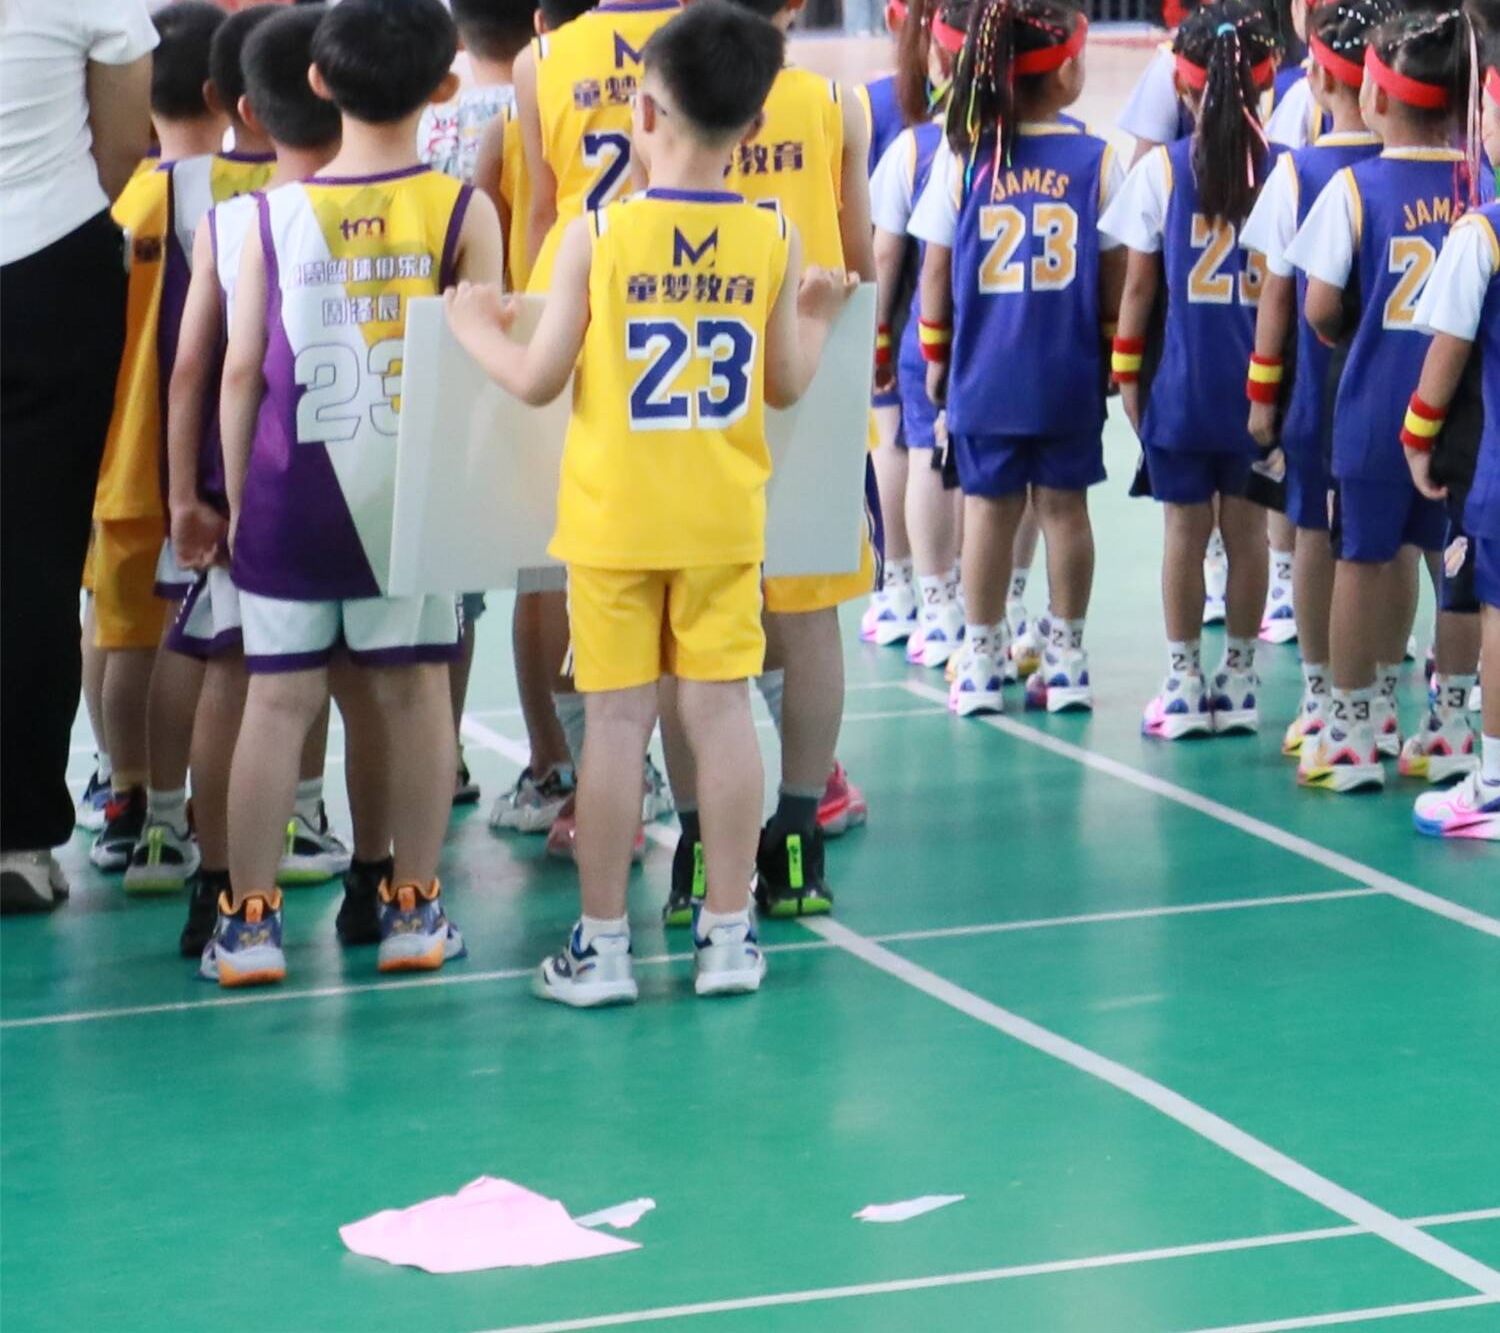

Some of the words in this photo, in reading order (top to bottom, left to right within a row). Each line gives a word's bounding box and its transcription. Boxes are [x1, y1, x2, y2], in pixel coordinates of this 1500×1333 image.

[724, 140, 804, 177] 教育
[626, 273, 756, 305] 童梦教育
[672, 225, 719, 268] M
[978, 201, 1078, 295] 23
[1382, 235, 1440, 331] 2
[294, 336, 405, 444] 23
[625, 316, 757, 432] 23
